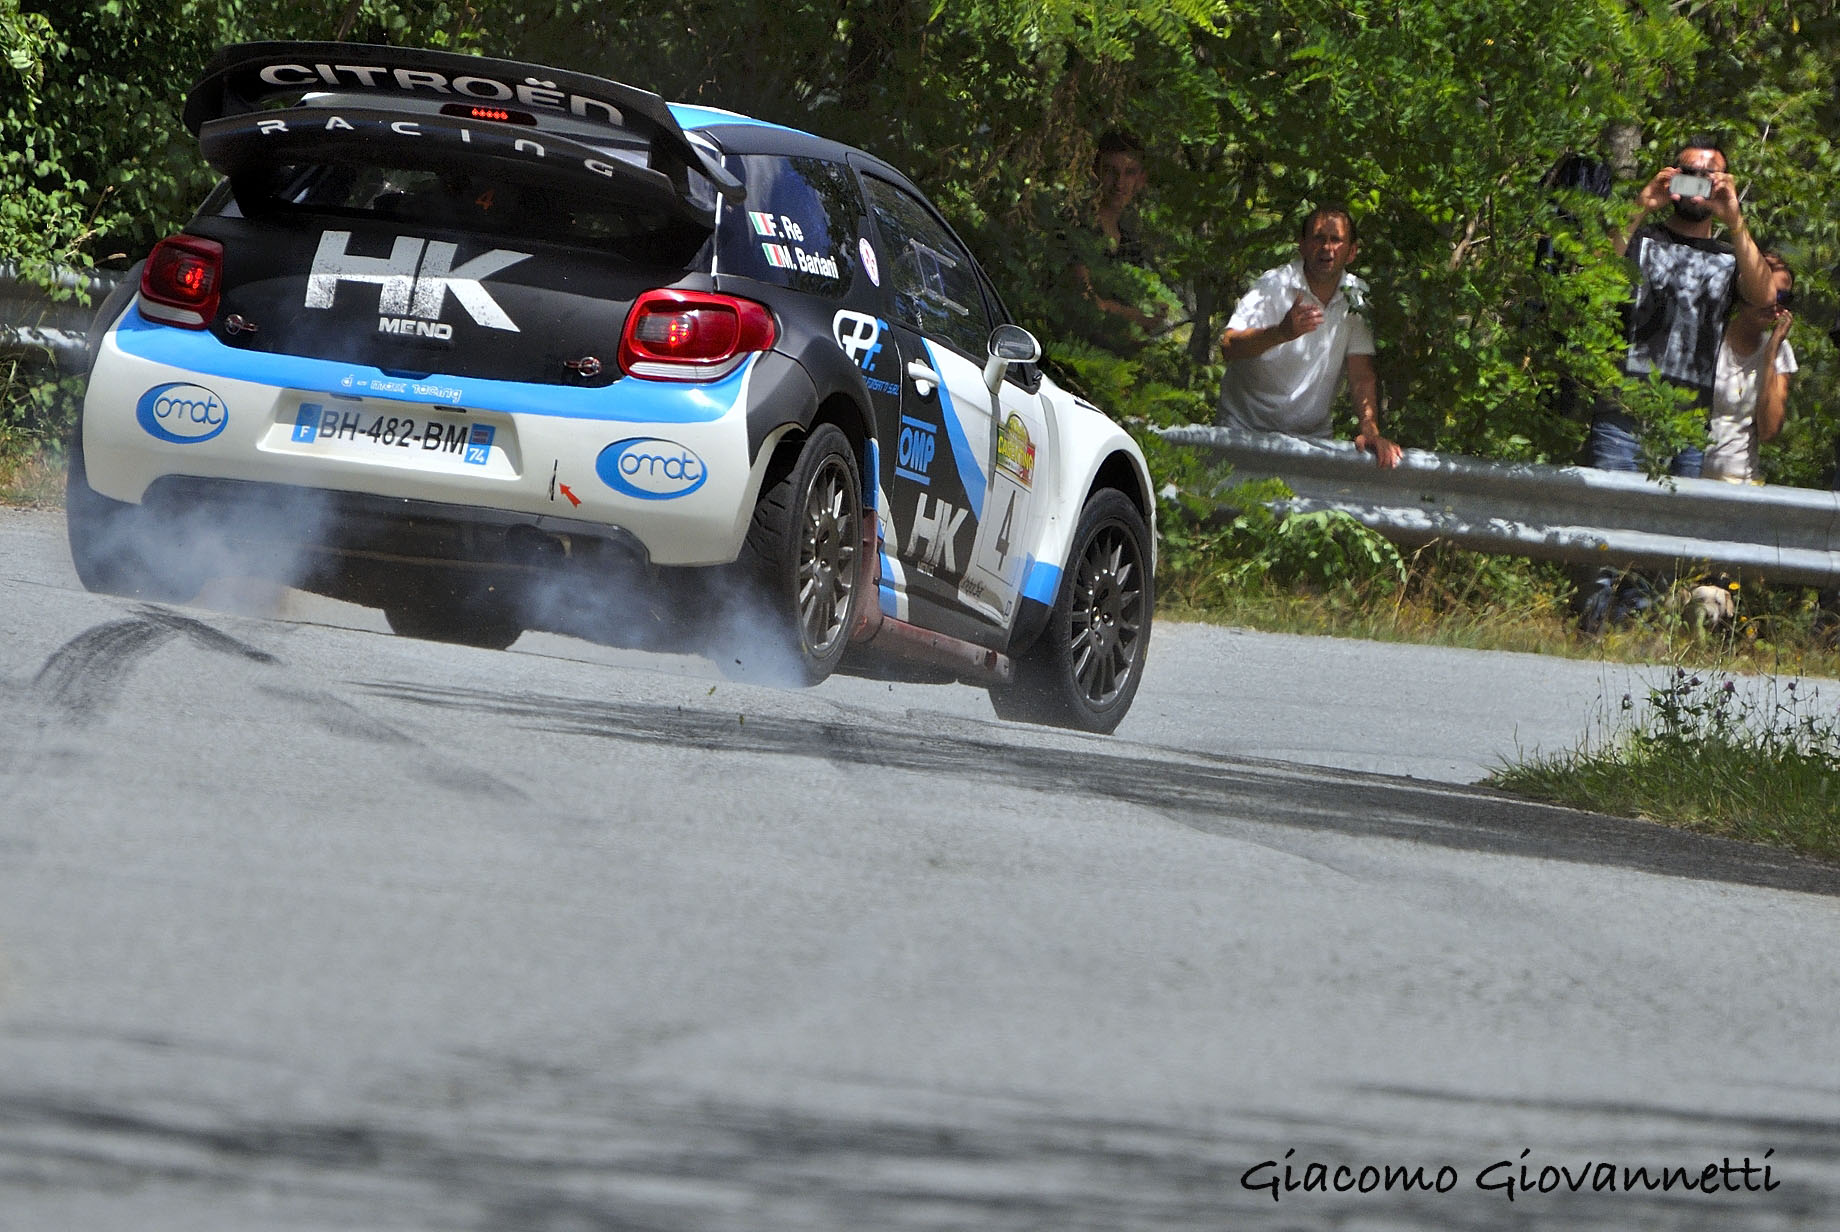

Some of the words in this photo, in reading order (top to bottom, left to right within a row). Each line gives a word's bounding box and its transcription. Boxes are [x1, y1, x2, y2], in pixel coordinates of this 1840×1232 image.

[475, 189, 496, 211] 4
[780, 215, 805, 242] Re
[794, 246, 840, 280] Bariani
[304, 230, 534, 333] HK
[378, 317, 453, 340] MENO
[299, 425, 309, 438] F
[318, 411, 468, 455] BH-482-BM
[469, 447, 485, 463] 74
[900, 427, 936, 473] OMP
[904, 492, 969, 573] HK
[996, 489, 1016, 572] 4
